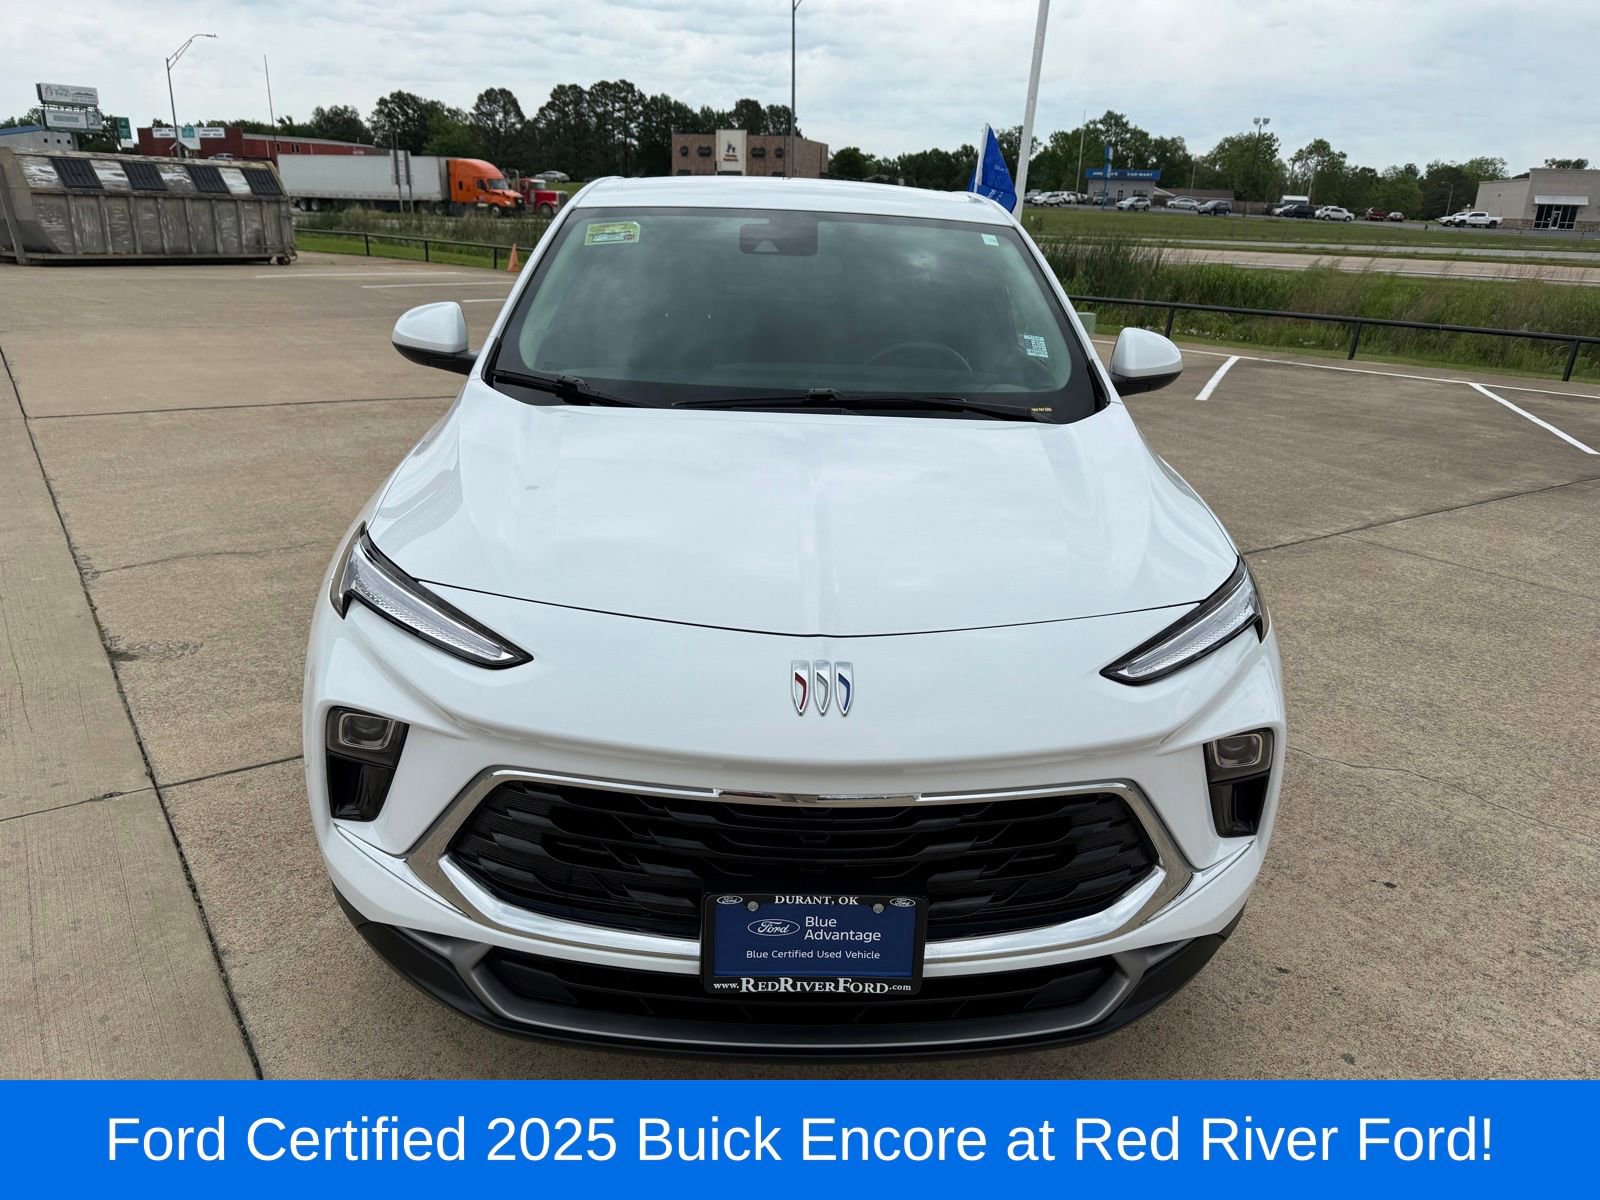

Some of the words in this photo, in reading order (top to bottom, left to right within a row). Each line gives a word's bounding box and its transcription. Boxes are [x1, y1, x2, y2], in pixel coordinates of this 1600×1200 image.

[774, 895, 835, 906] DURANT,
[838, 896, 859, 905] OK
[805, 916, 837, 927] Blue
[757, 921, 790, 934] Ford
[804, 929, 881, 943] Advantage
[746, 950, 769, 959] Blue
[771, 950, 814, 959] Certified
[816, 950, 842, 959] Used
[845, 951, 880, 960] Vehicle
